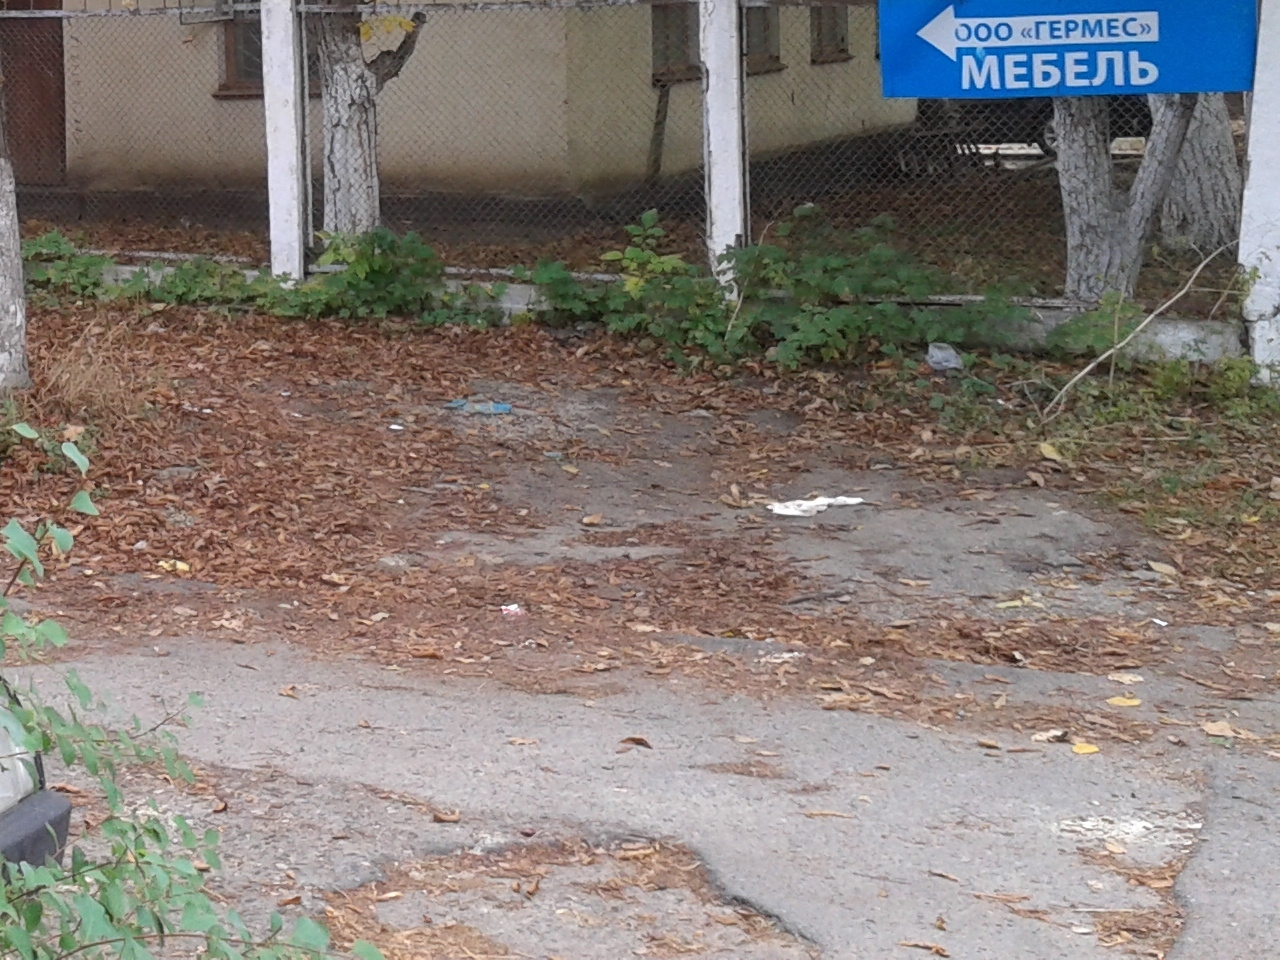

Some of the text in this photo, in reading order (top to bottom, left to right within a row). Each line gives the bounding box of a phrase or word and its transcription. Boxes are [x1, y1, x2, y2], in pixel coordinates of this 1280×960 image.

[954, 17, 1152, 43] ООО «ГЕРМЕС»
[961, 50, 1160, 90] МЕБЕЛЬ
